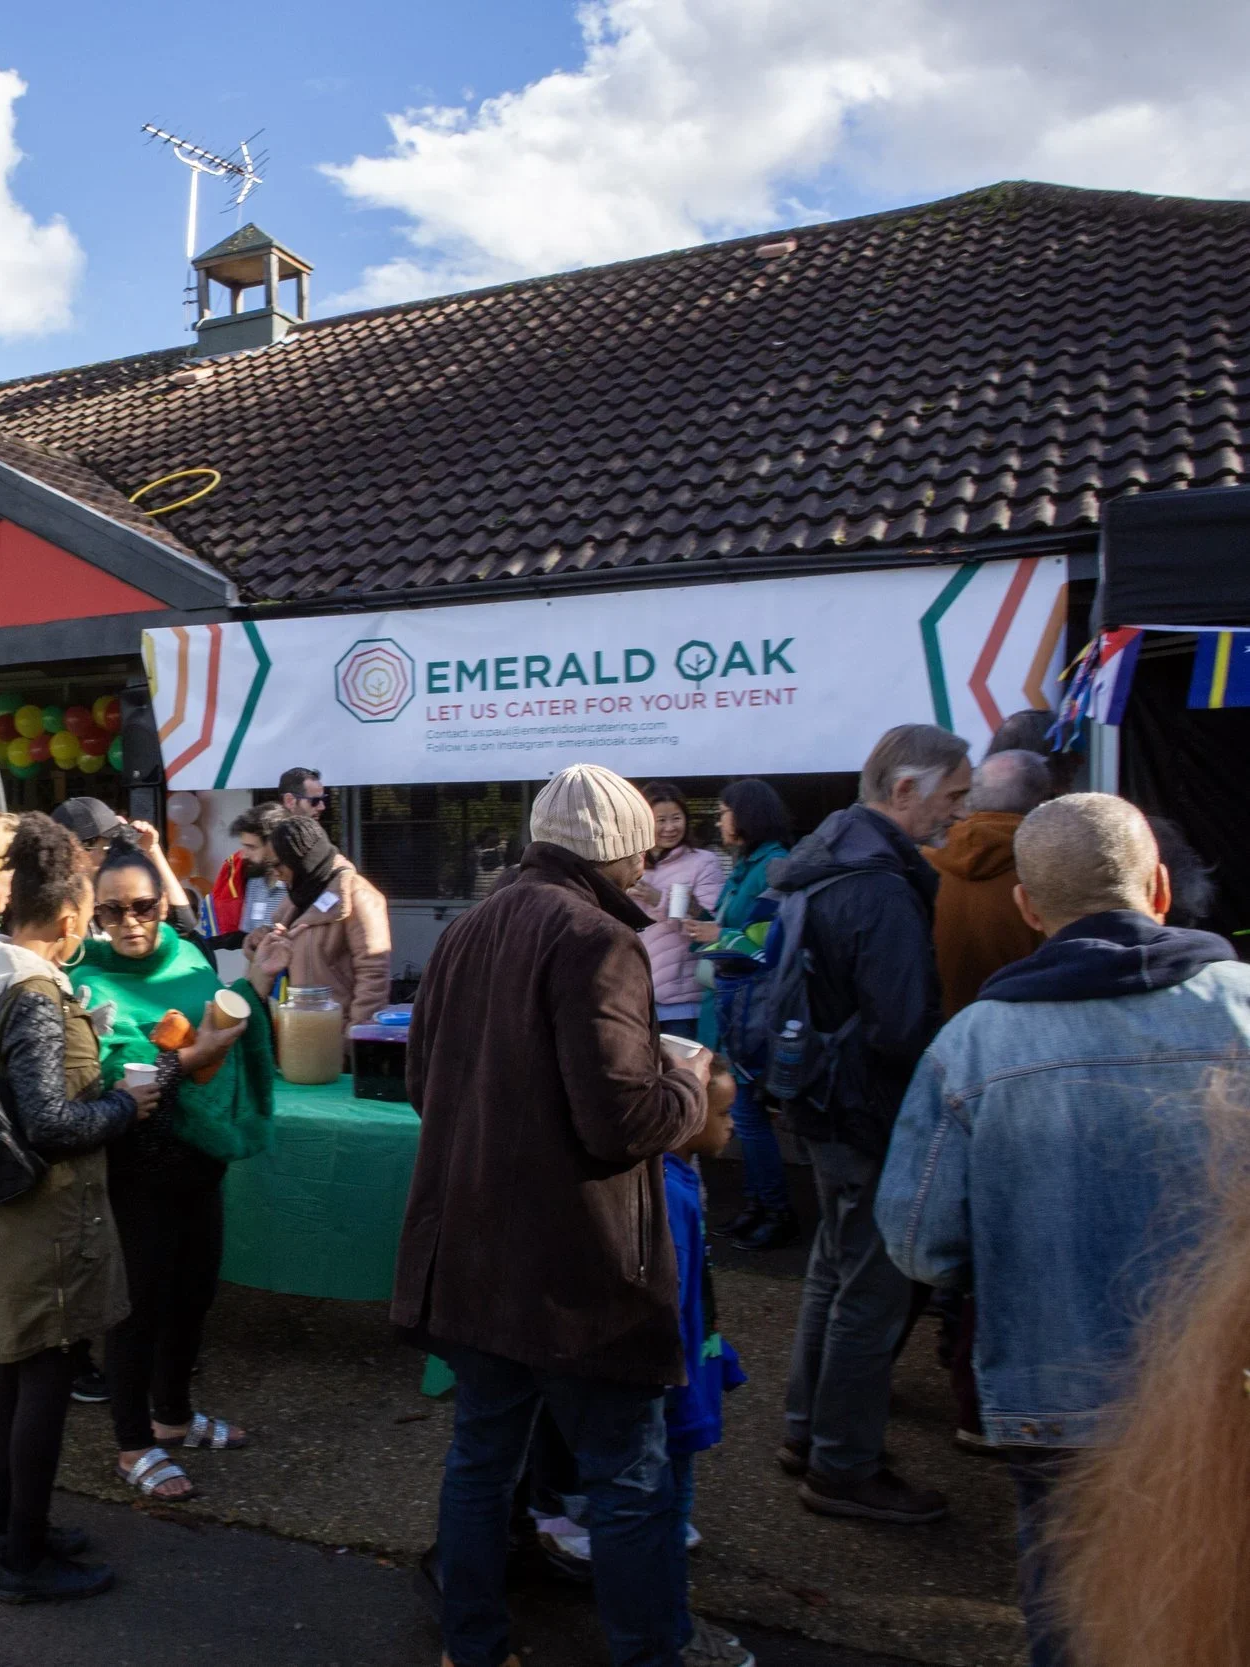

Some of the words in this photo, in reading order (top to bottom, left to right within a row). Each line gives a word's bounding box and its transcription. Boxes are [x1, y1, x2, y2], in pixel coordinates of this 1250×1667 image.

[425, 648, 656, 694] EMERALD
[674, 637, 797, 685] OAK
[425, 703, 463, 721] LET
[470, 702, 498, 720] US
[505, 698, 577, 718] CATER
[585, 696, 632, 715] FOR
[640, 692, 707, 713] YOUR
[715, 687, 798, 708] EVENT
[425, 729, 469, 739] Contact
[425, 742, 462, 752] Follow
[465, 743, 477, 752] us
[481, 742, 495, 751] on
